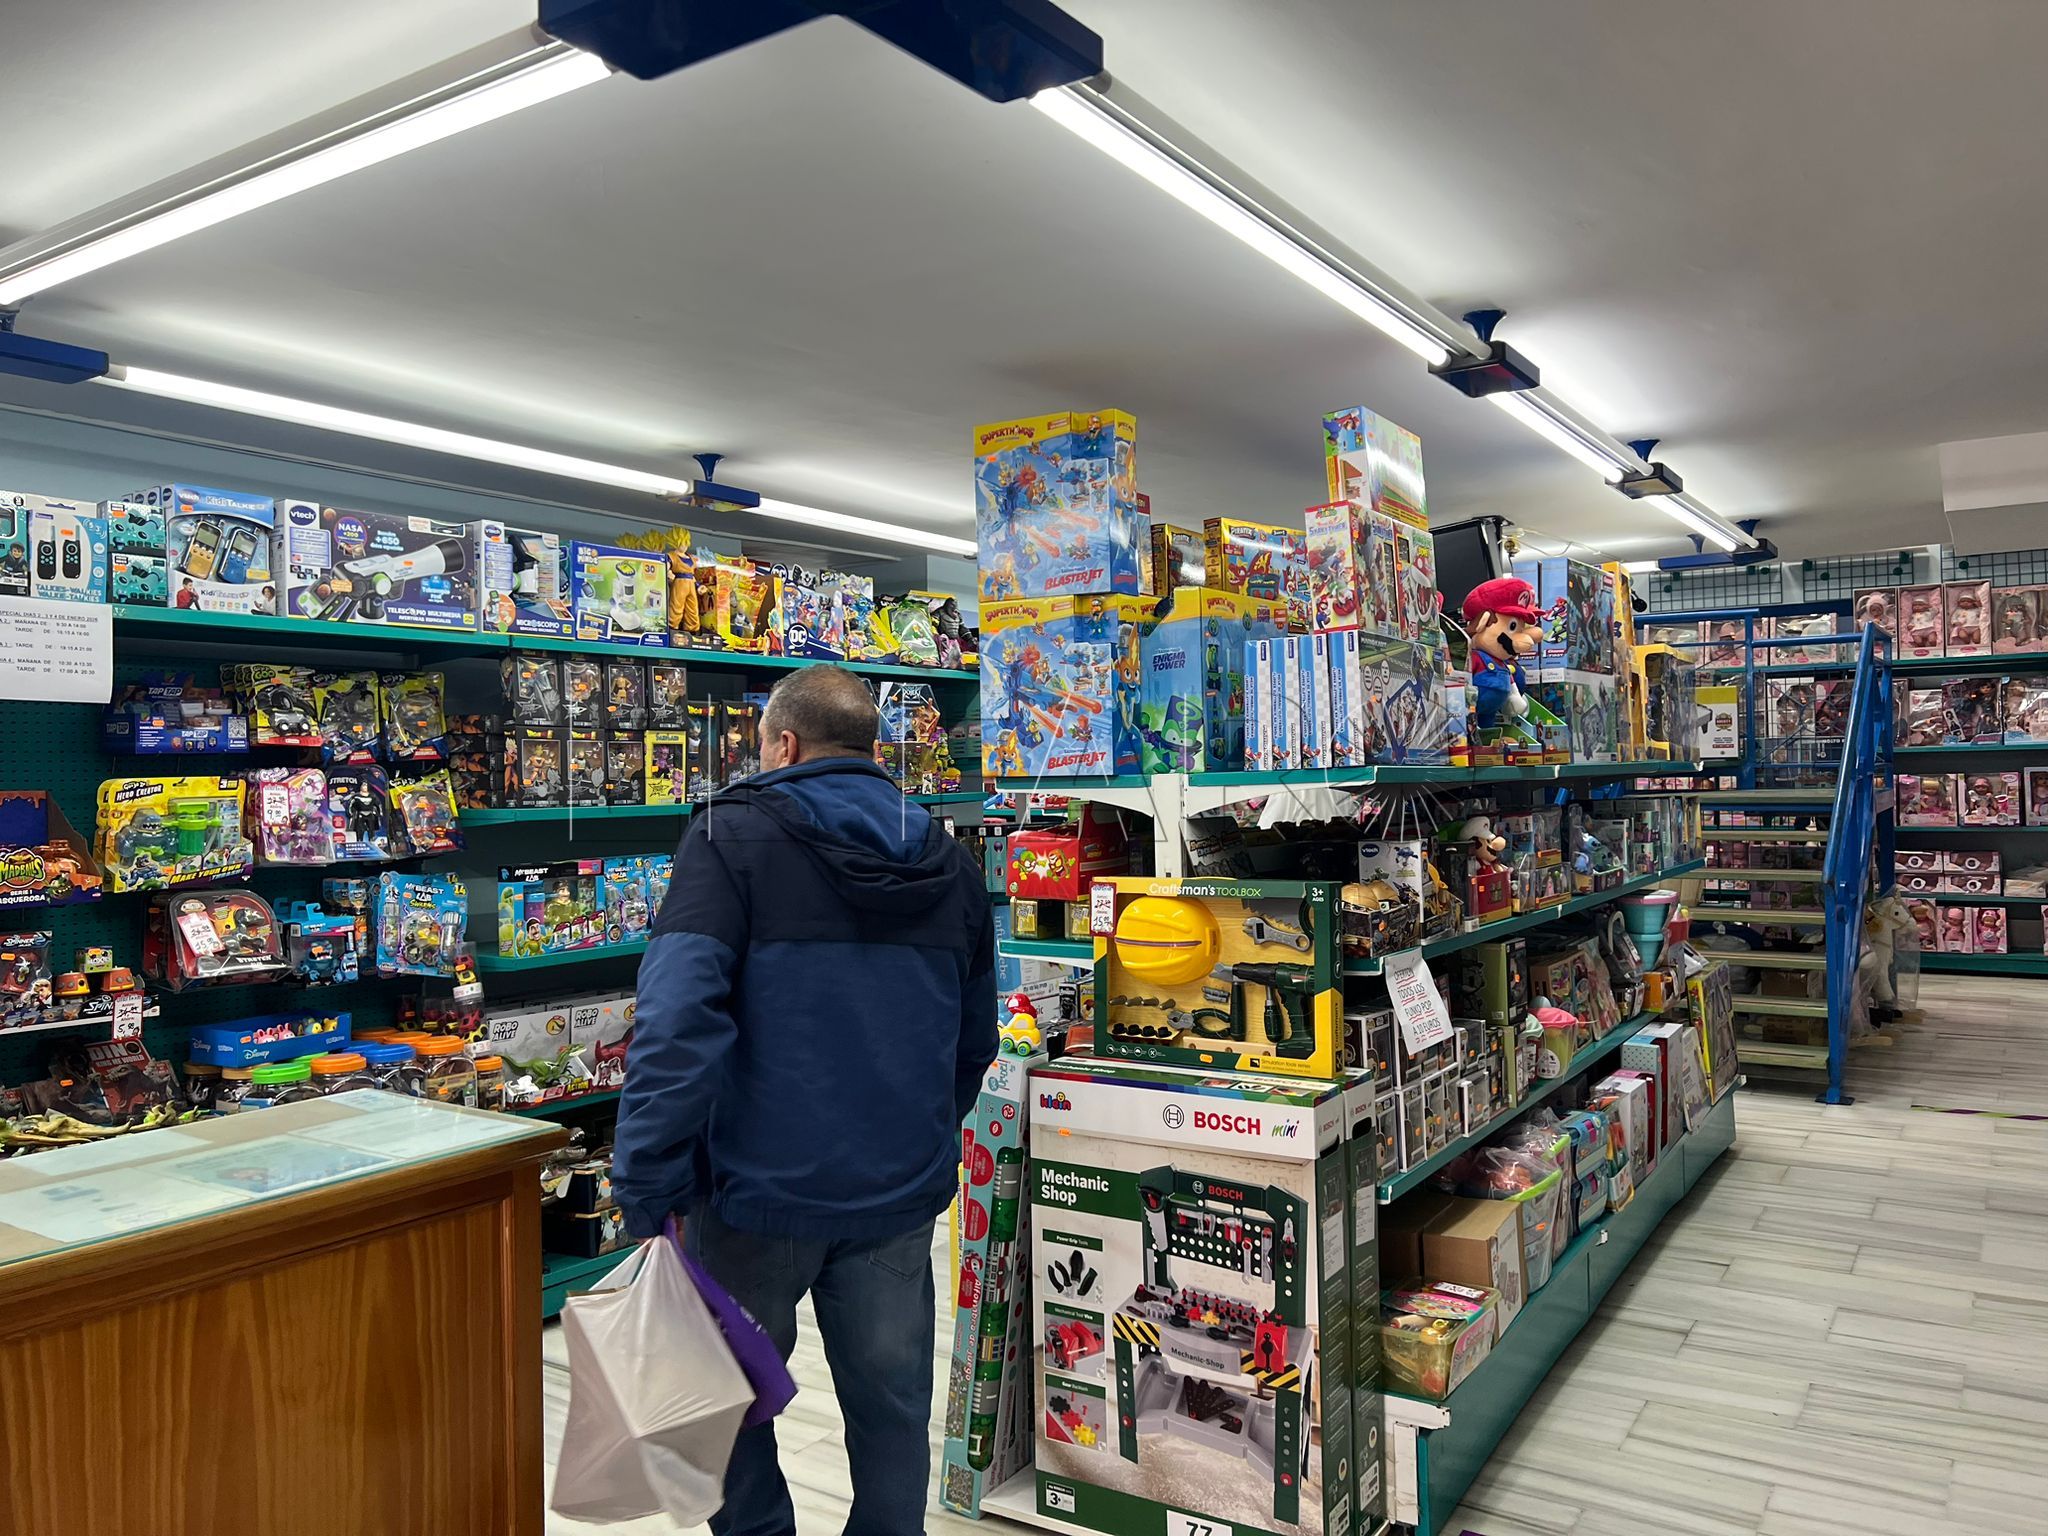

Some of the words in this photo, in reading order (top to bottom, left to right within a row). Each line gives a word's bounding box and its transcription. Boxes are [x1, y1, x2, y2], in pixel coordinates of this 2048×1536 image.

[980, 425, 1036, 445] SUPERTHINGS
[290, 510, 315, 520] vtech
[338, 523, 364, 533] NASA
[645, 564, 656, 574] 30
[387, 606, 426, 618] TELESCOPIO
[985, 605, 1038, 622] SUPERTHINGS
[790, 629, 807, 644] DC
[1152, 651, 1186, 665] ENIGMA
[1152, 660, 1186, 672] TOWER
[149, 687, 164, 696] TAP
[330, 776, 358, 785] STRETCH
[116, 790, 135, 802] HERO
[136, 784, 162, 798] CREATOR
[636, 858, 642, 867] 6
[170, 872, 194, 884] MAKE
[196, 868, 220, 880] YOUR
[221, 864, 244, 874] OWN
[454, 884, 466, 896] 14
[1149, 883, 1216, 896] Craftsman's
[1216, 887, 1262, 898] TOOLBOX
[1312, 888, 1324, 897] 3+
[1398, 986, 1414, 999] TODOS
[1414, 983, 1425, 994] LOS
[576, 1008, 598, 1020] ROBO
[1404, 1004, 1422, 1018] FUNKO
[1421, 1000, 1432, 1012] POP
[494, 1021, 518, 1034] ROBO
[574, 1016, 596, 1028] ALIVE
[1424, 1018, 1441, 1032] EUROS
[492, 1031, 516, 1042] ALIVE
[122, 1054, 145, 1064] WORLD
[244, 1049, 270, 1060] Disney
[1040, 1092, 1072, 1111] klein
[1194, 1111, 1261, 1136] BOSCH
[1271, 1118, 1300, 1138] mini
[1041, 1168, 1110, 1193] Mechanic
[1041, 1184, 1078, 1206] Shop
[1208, 1184, 1244, 1201] BOSCH
[970, 1278, 984, 1331] Alfombra
[970, 1332, 976, 1344] de
[965, 1346, 974, 1382] juego
[1050, 1492, 1062, 1506] 3+
